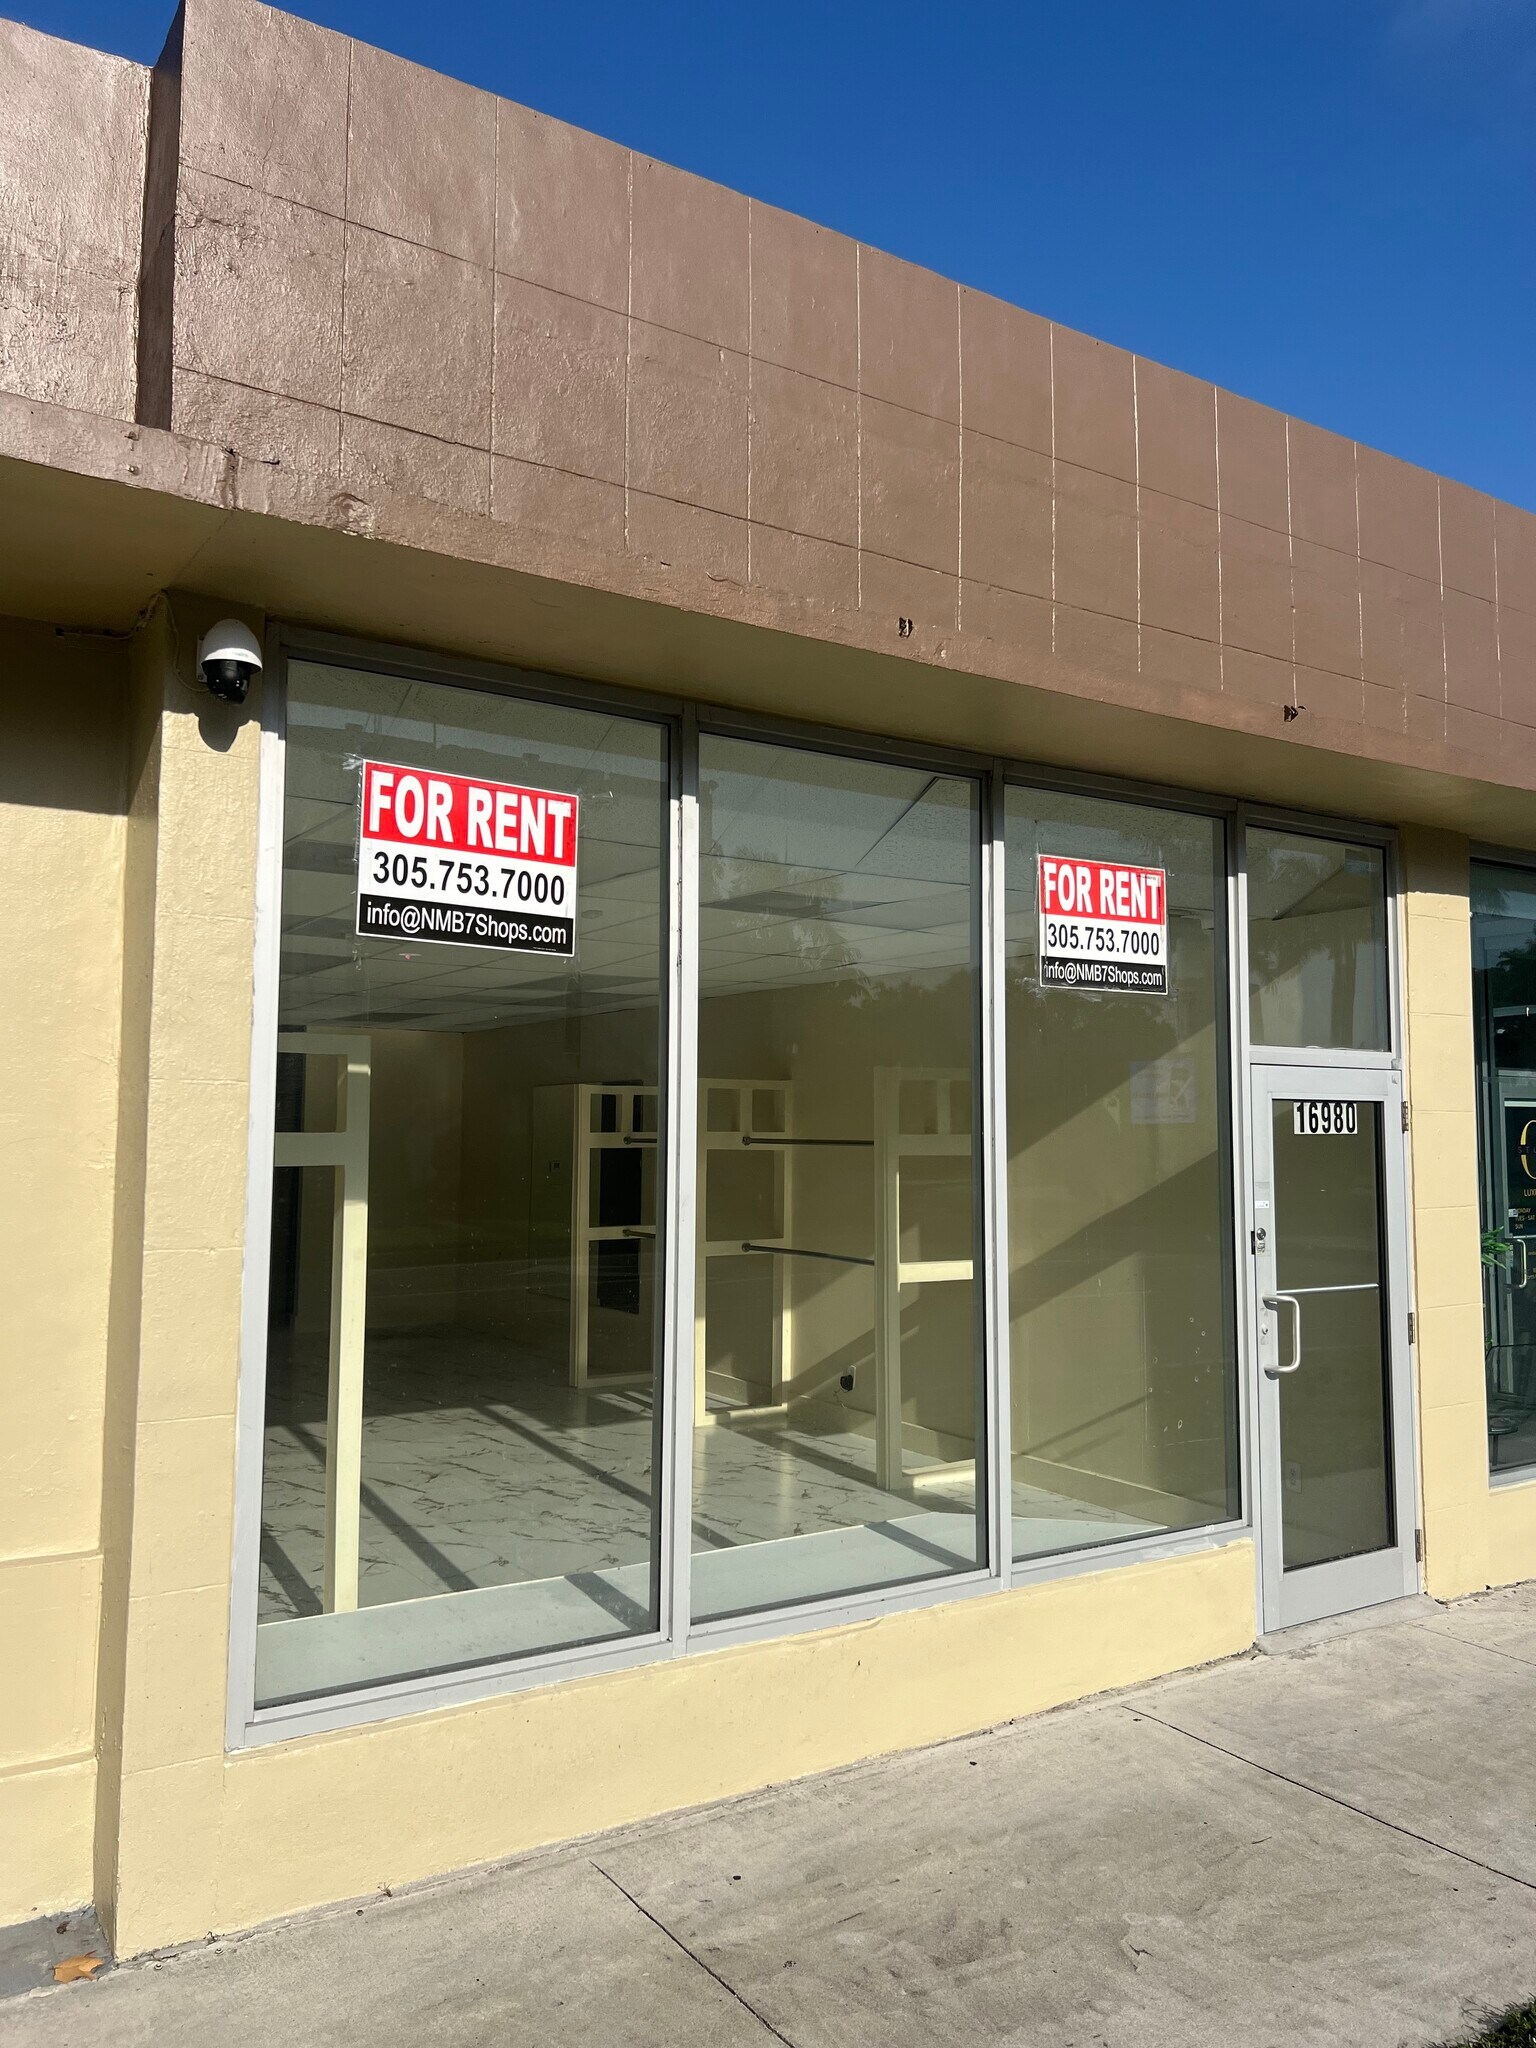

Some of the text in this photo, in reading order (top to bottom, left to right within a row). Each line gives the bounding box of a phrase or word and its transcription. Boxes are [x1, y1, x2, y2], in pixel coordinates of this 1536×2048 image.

[369, 770, 572, 859] FOR RENT
[373, 851, 565, 905] 305.753.7000
[1043, 862, 1162, 920] FOR RENT
[366, 901, 567, 945] info@NMB7Shops.com
[1048, 923, 1160, 956] 305.753.7000
[1045, 961, 1163, 987] info@NMB7Shops.com
[1297, 1102, 1356, 1133] 16980
